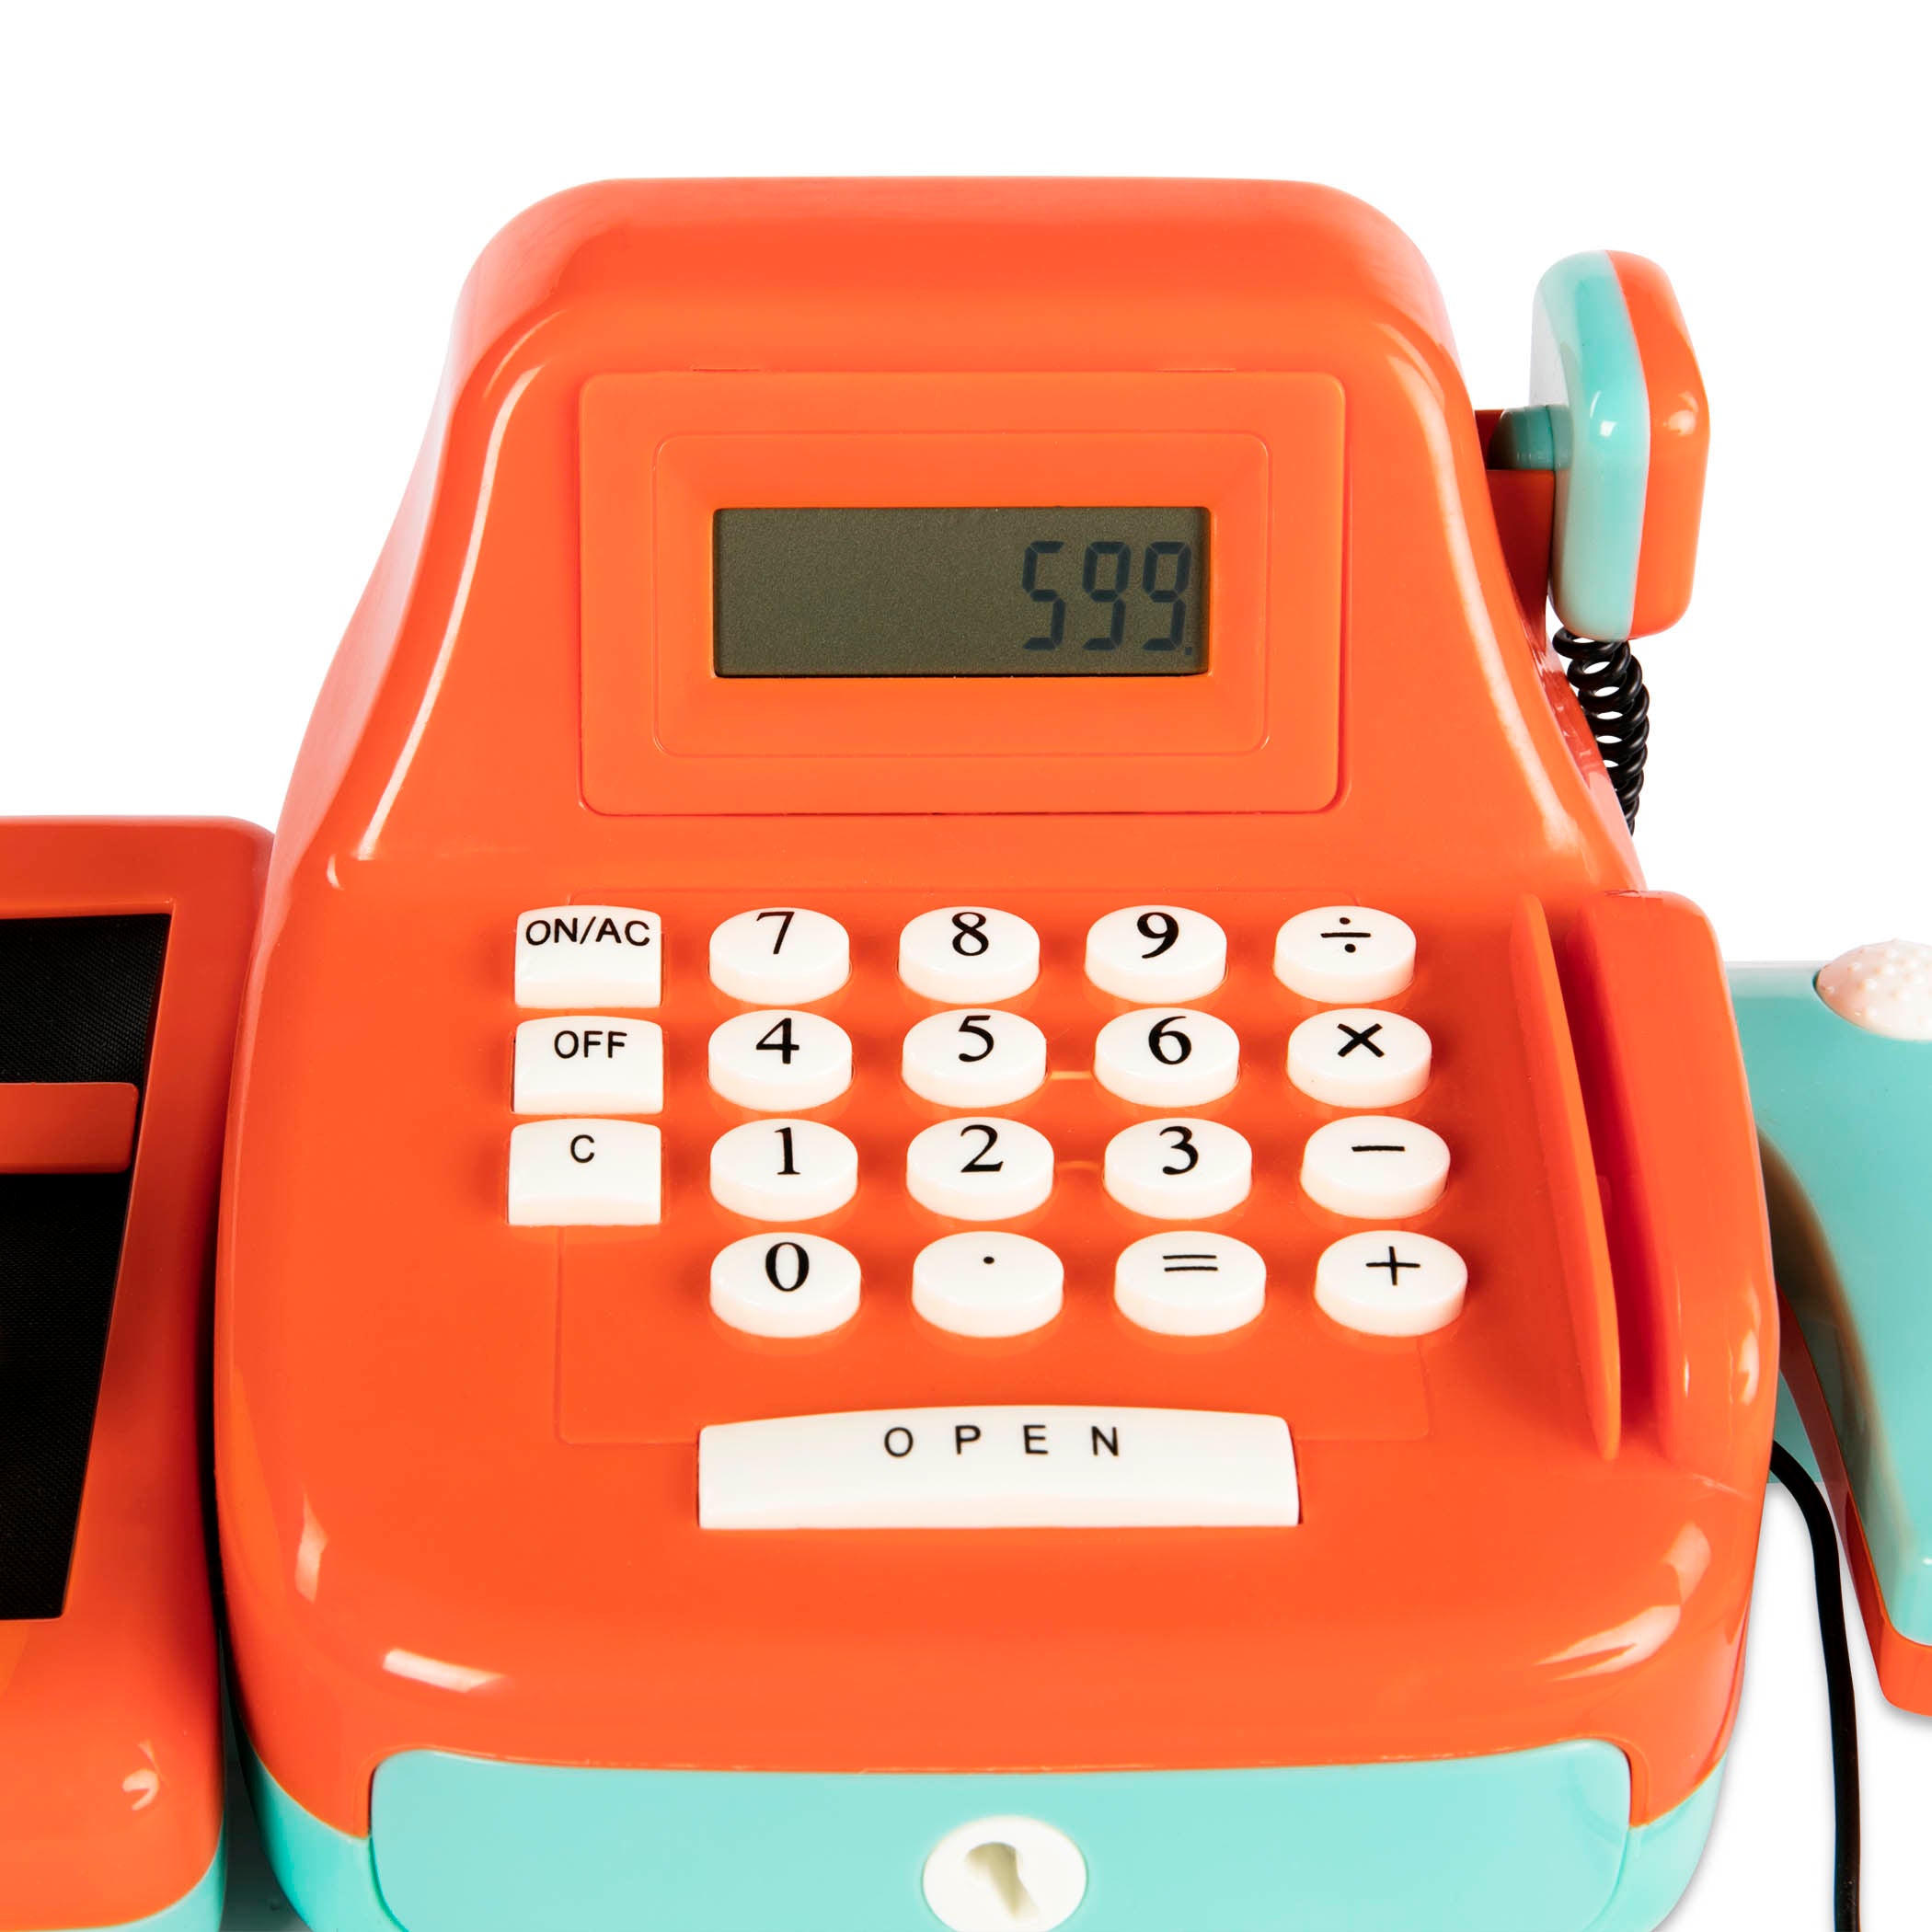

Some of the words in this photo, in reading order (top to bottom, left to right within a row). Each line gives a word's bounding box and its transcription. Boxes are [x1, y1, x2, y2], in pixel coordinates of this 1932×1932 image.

[525, 915, 650, 947] ON/AC
[756, 911, 795, 955] 7
[951, 911, 989, 957] 8
[1136, 912, 1179, 960] 9
[554, 1029, 627, 1059] OFF
[755, 1018, 800, 1064] 4
[958, 1015, 995, 1063] 5
[1148, 1016, 1192, 1065] 6
[569, 1134, 595, 1164] C
[775, 1126, 800, 1176] 1
[960, 1124, 1004, 1173] 2
[1159, 1125, 1199, 1176] 3
[765, 1241, 810, 1293] 0
[882, 1423, 1119, 1458] OPEN
